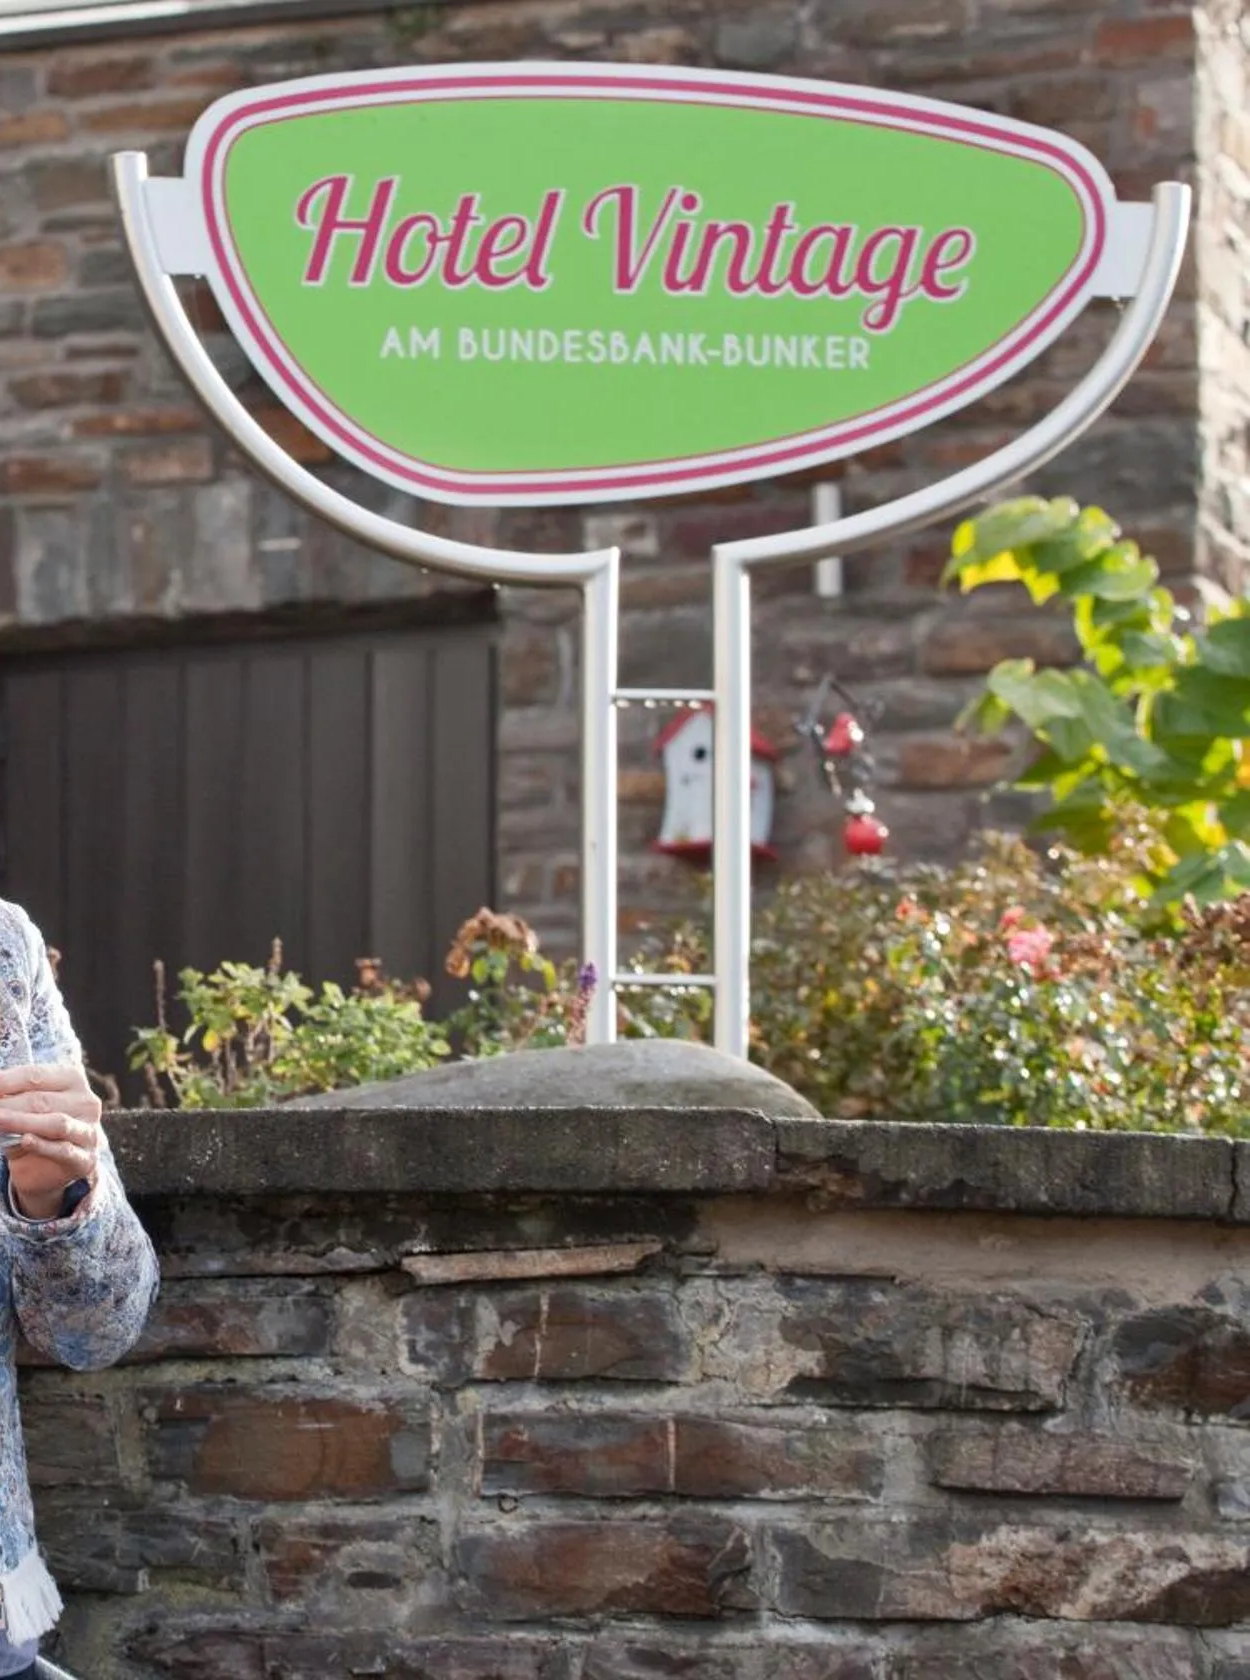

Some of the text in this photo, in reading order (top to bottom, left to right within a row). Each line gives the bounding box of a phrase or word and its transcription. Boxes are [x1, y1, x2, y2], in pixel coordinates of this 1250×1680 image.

[297, 174, 976, 333] Hotel Vintage
[380, 326, 870, 370] AM BUNDESBANK-BUNKER
